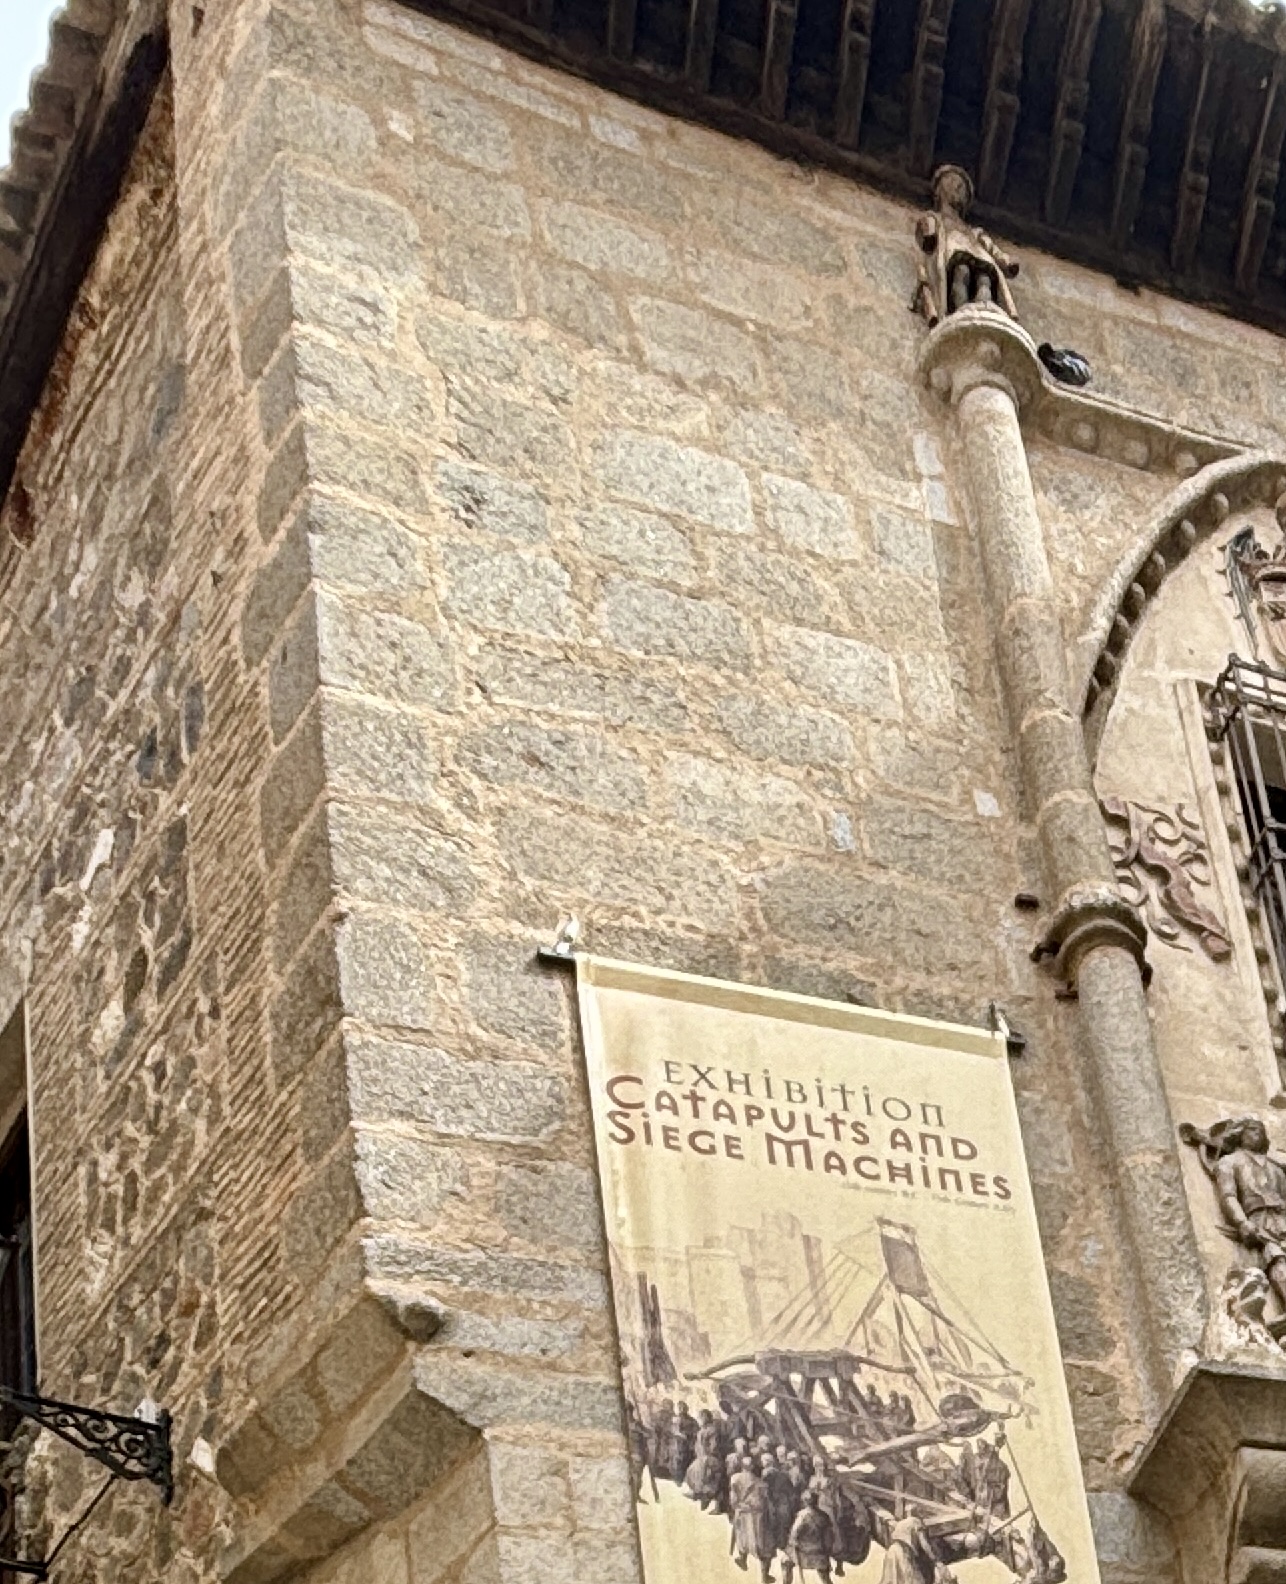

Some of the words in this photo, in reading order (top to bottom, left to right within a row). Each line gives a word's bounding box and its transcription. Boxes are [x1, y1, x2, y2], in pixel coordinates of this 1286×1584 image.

[605, 1074, 870, 1146] CATAPULTS
[889, 1127, 978, 1161] AND
[606, 1110, 745, 1161] SIEGE
[765, 1131, 1012, 1201] MACHINES
